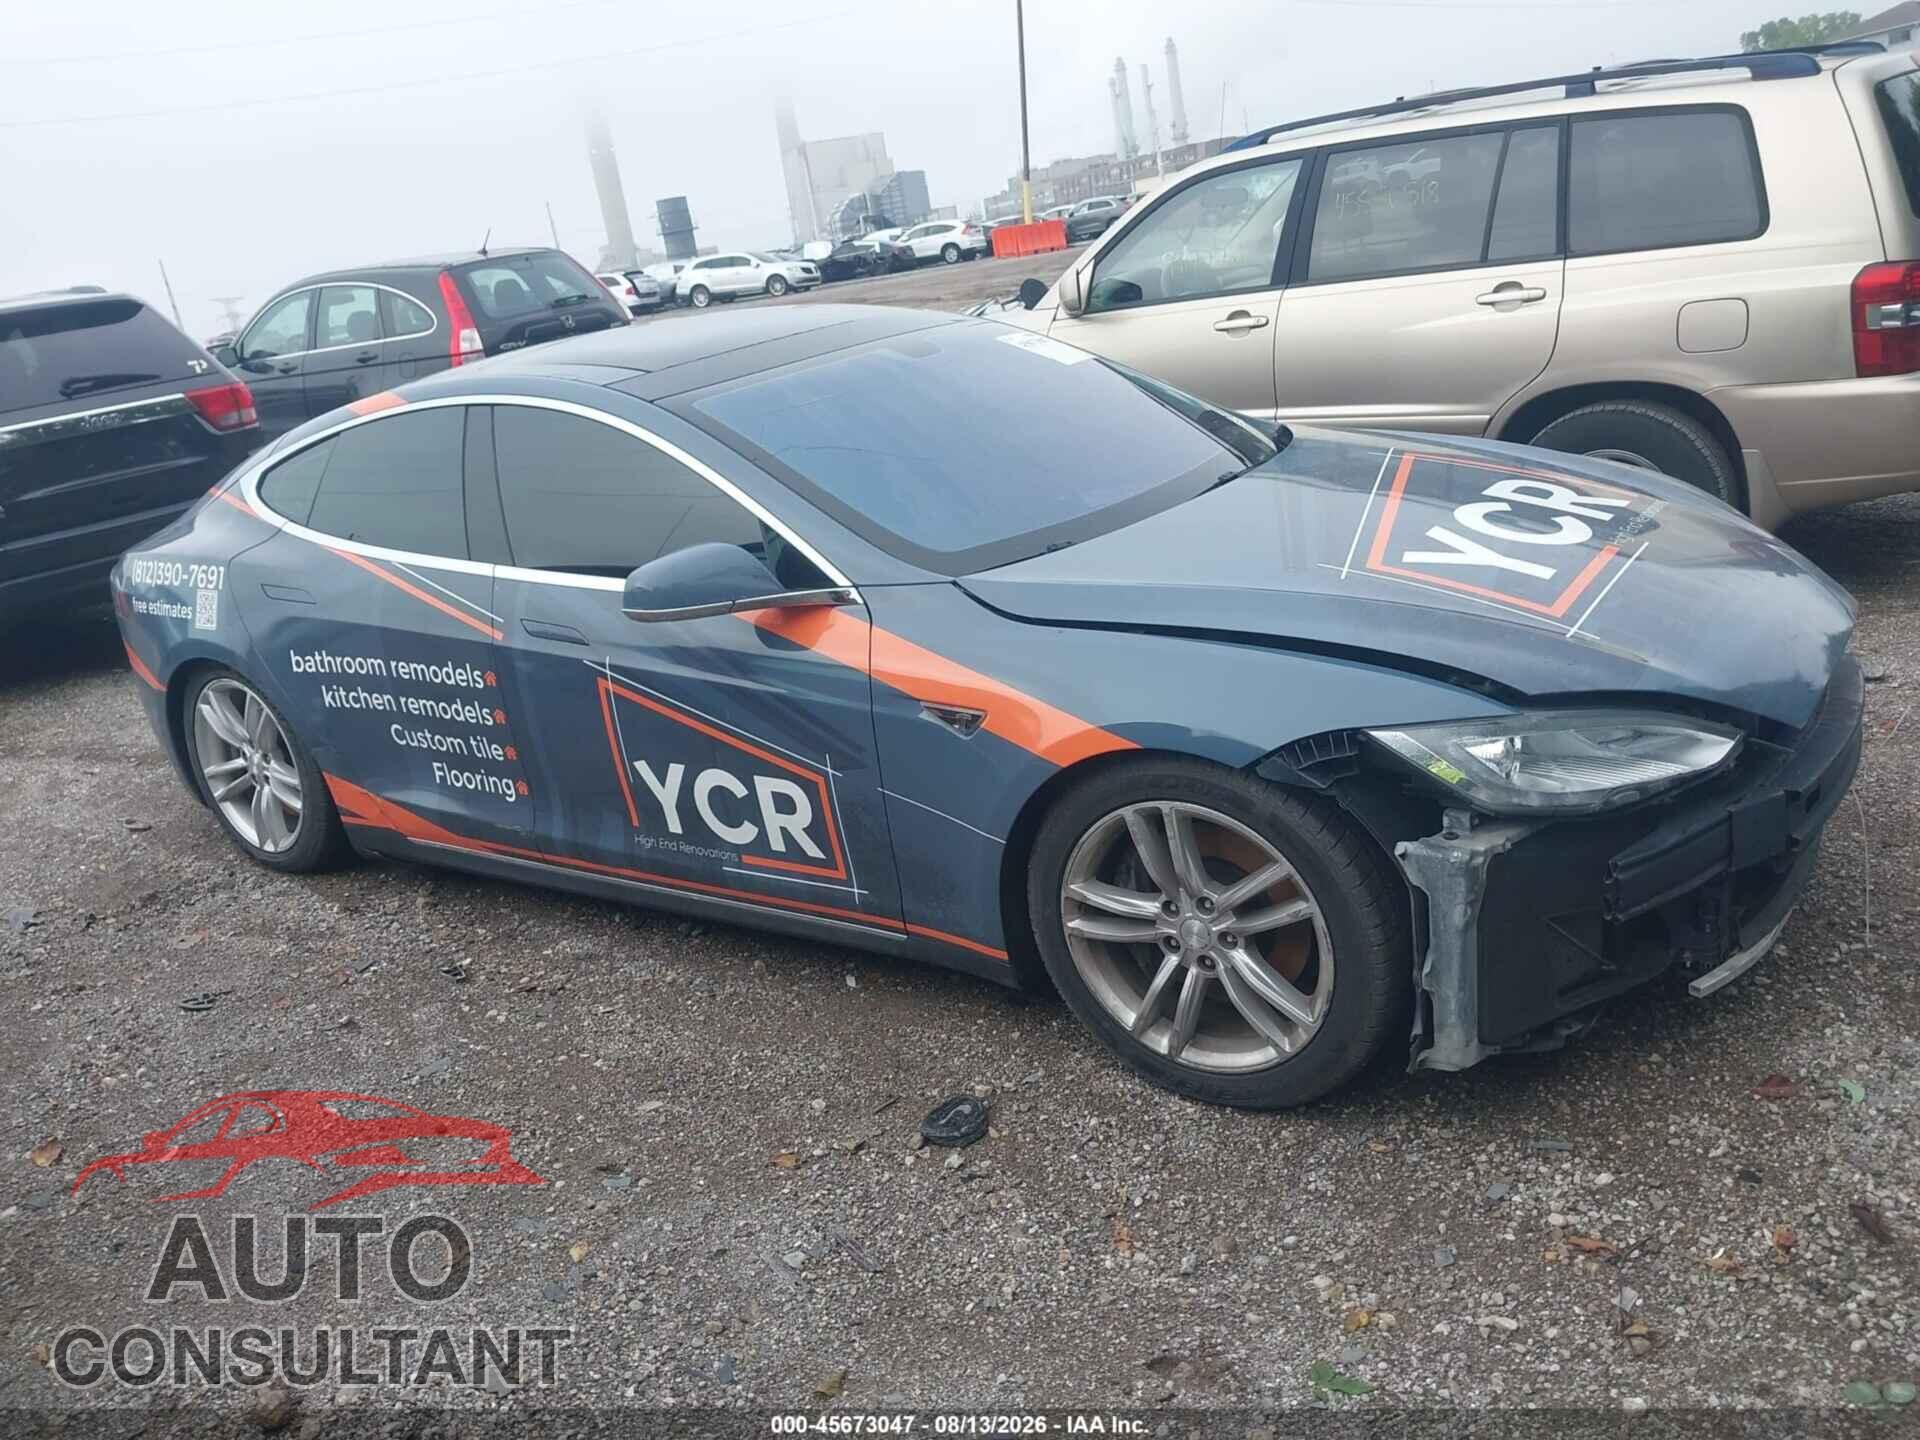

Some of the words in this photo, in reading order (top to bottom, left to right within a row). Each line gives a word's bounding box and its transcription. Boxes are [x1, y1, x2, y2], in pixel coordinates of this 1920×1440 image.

[1401, 478, 1633, 581] YCR
[131, 560, 225, 591] (812)390-7691
[132, 596, 147, 614] free
[148, 600, 193, 620] estimates
[290, 650, 388, 678] bathroom
[389, 657, 485, 689] remodels
[322, 685, 398, 712] kitchen
[398, 692, 494, 727] remodels
[390, 723, 467, 756] Custom
[469, 733, 505, 762] tile
[431, 762, 516, 803] Flooring
[632, 759, 828, 860] YCR
[633, 834, 657, 849] High
[659, 837, 677, 852] End
[679, 841, 739, 862] Renovations
